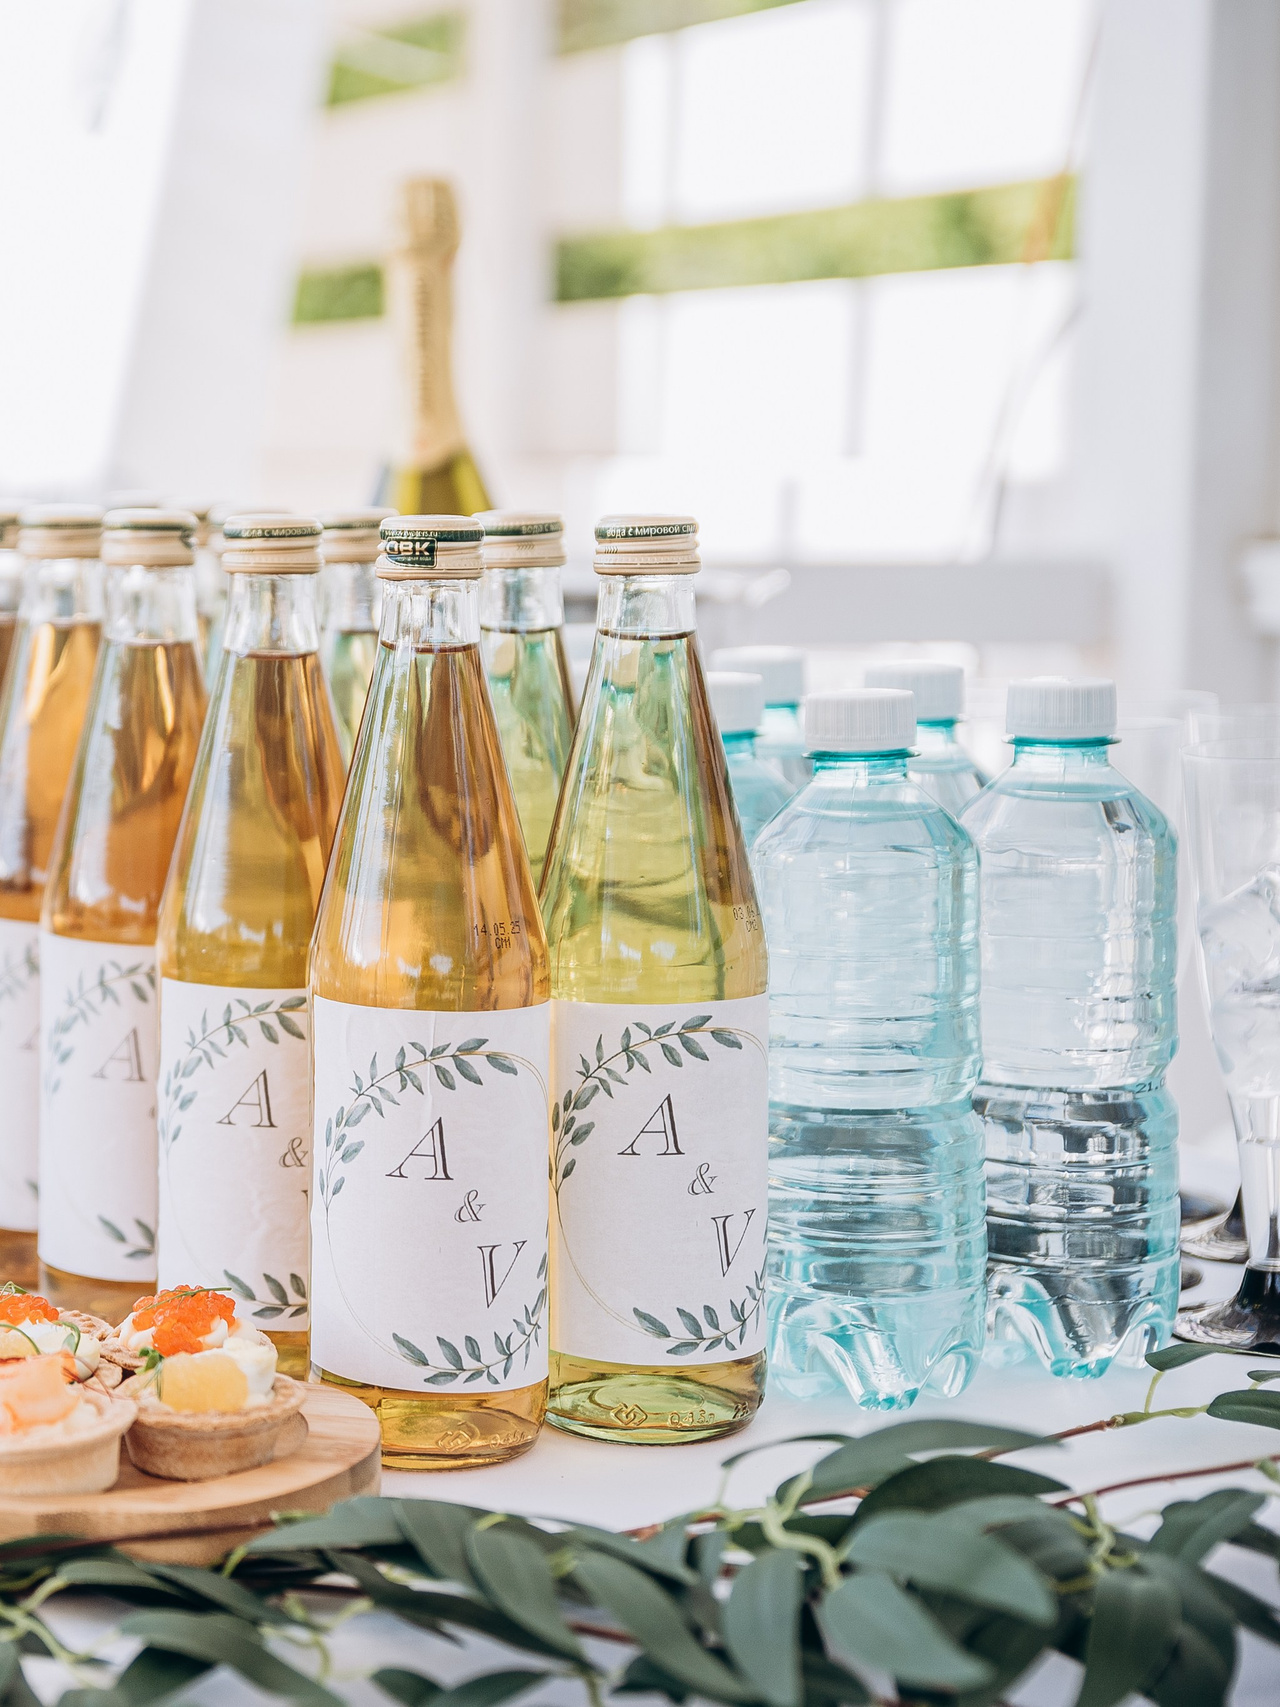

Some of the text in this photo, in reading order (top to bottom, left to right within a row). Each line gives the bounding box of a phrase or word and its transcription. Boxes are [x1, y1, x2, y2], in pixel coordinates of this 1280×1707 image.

[473, 920, 521, 936] 14.05.25
[91, 1026, 147, 1082] A
[215, 1068, 279, 1129] A
[617, 1093, 685, 1157] A
[279, 1136, 307, 1169] &
[385, 1116, 454, 1181] A
[454, 1189, 483, 1223] &
[687, 1162, 716, 1197] &
[711, 1208, 756, 1278] V
[477, 1240, 528, 1309] V
